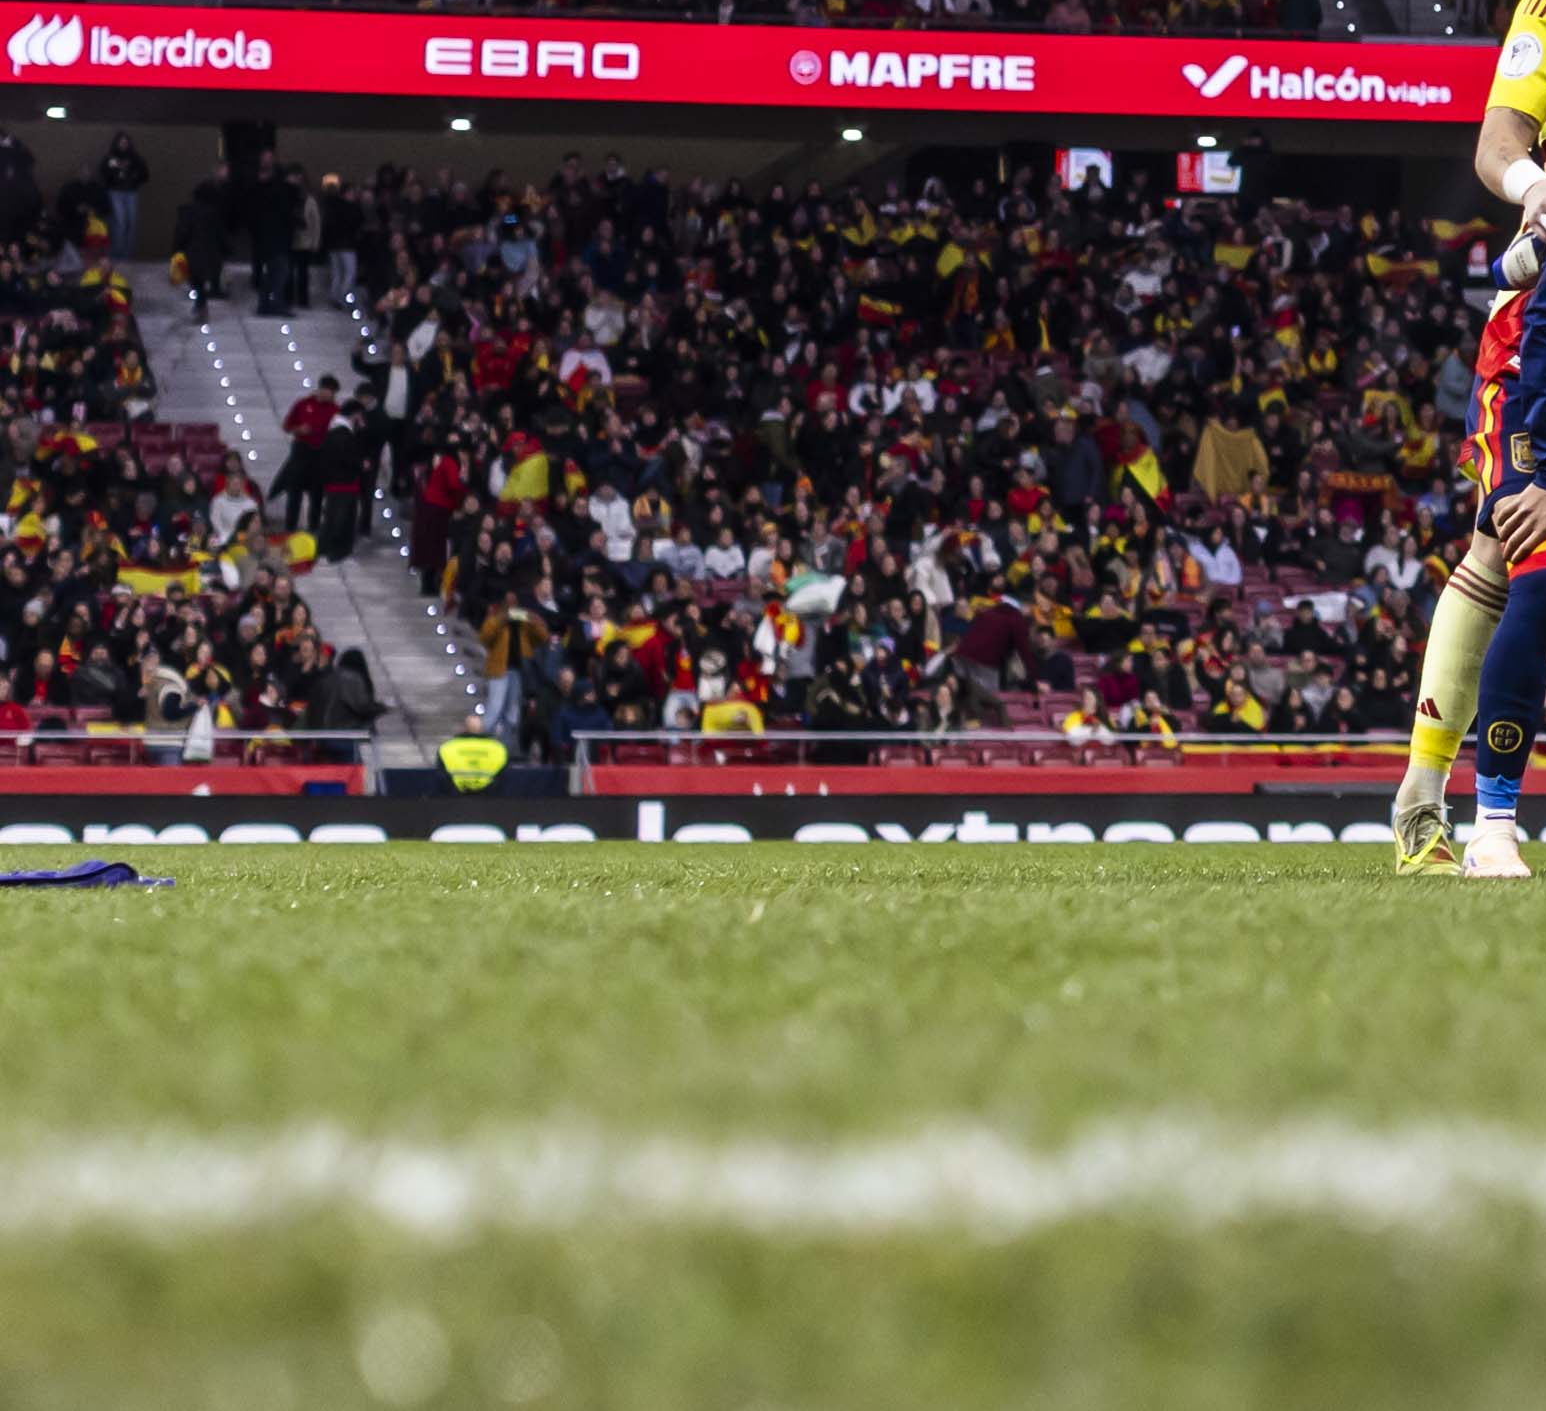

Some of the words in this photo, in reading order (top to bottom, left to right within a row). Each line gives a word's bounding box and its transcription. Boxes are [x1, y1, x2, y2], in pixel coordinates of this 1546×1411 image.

[91, 27, 272, 70] Iberdrola
[426, 38, 640, 80] EBRO
[830, 50, 1035, 91] MAPFRE
[1250, 64, 1384, 102] Halcón
[1386, 84, 1452, 106] viajes
